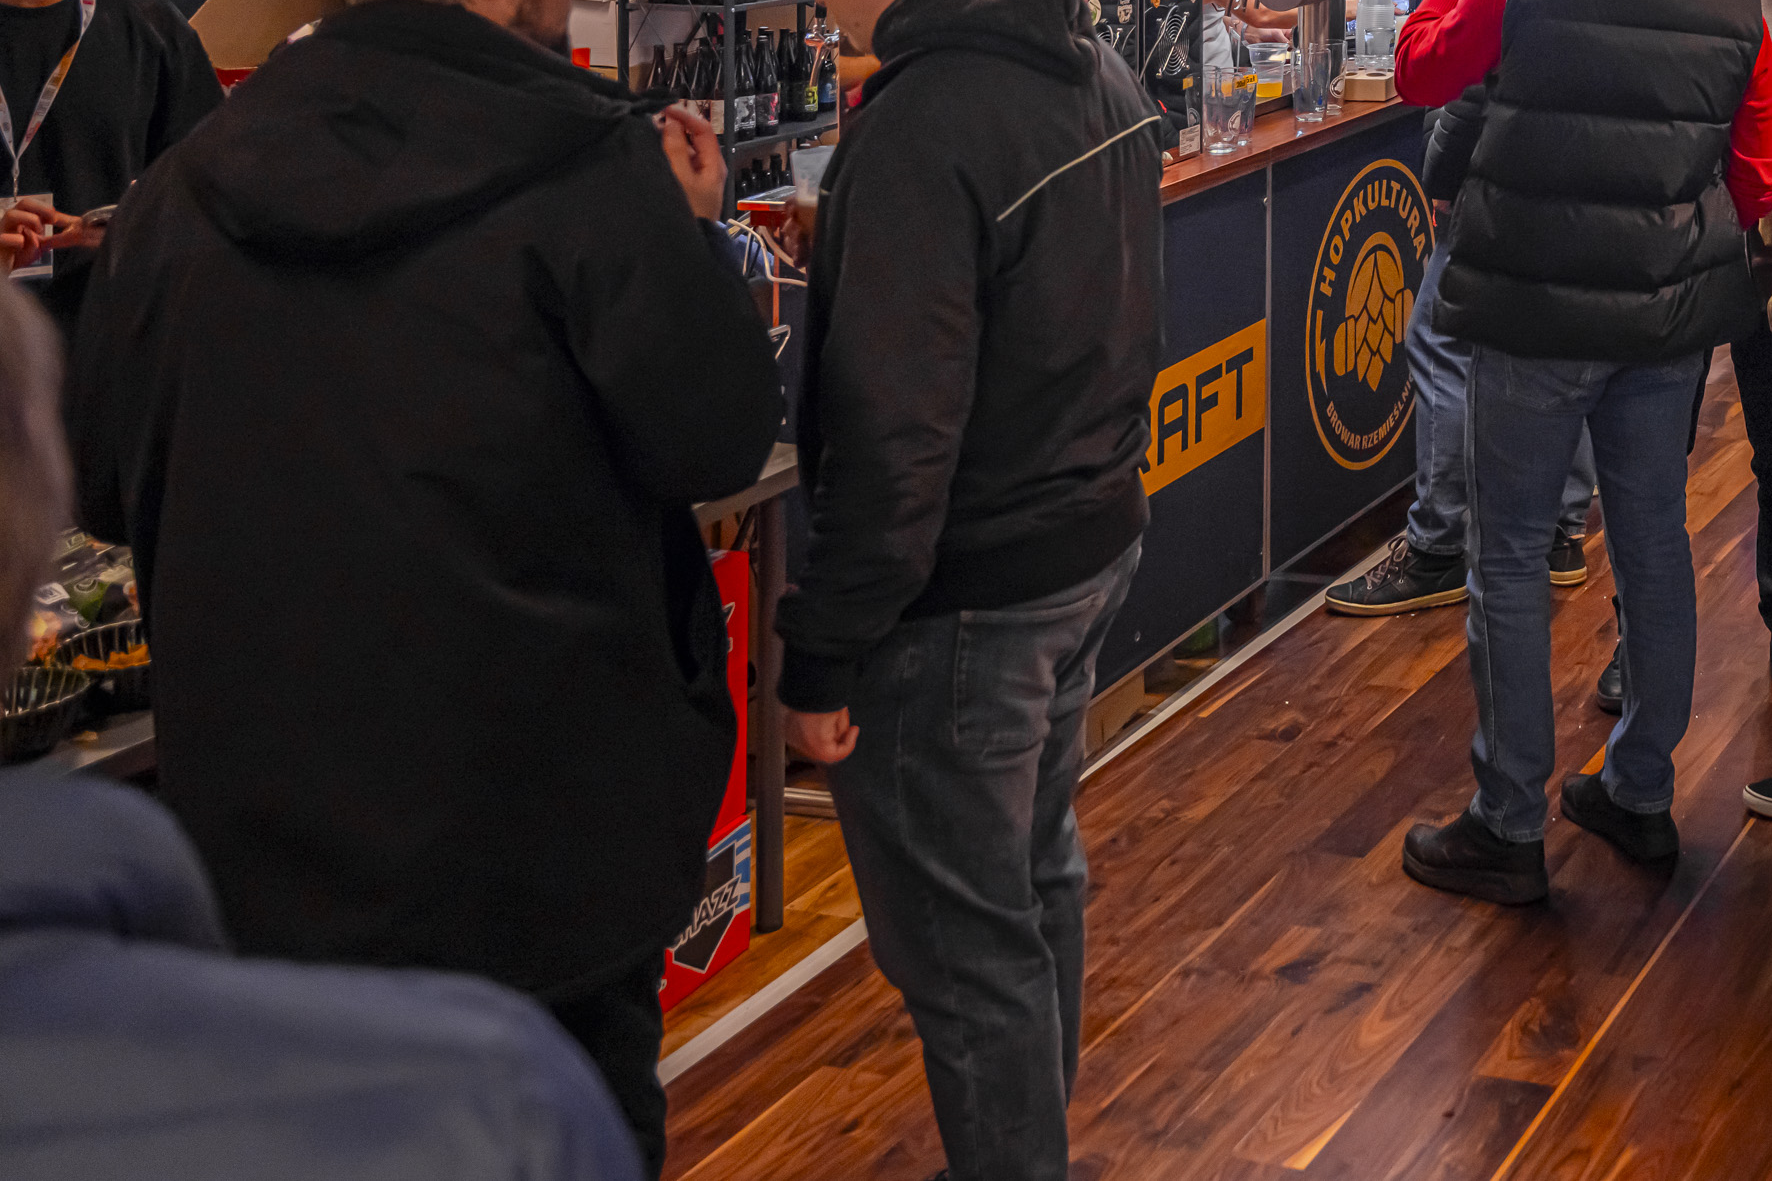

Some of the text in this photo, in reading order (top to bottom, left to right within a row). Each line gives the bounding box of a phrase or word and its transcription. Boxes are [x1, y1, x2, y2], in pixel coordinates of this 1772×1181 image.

[1318, 178, 1429, 298] HOPKULTURA
[1139, 346, 1254, 475] AFT
[1326, 400, 1361, 451] BROWAR
